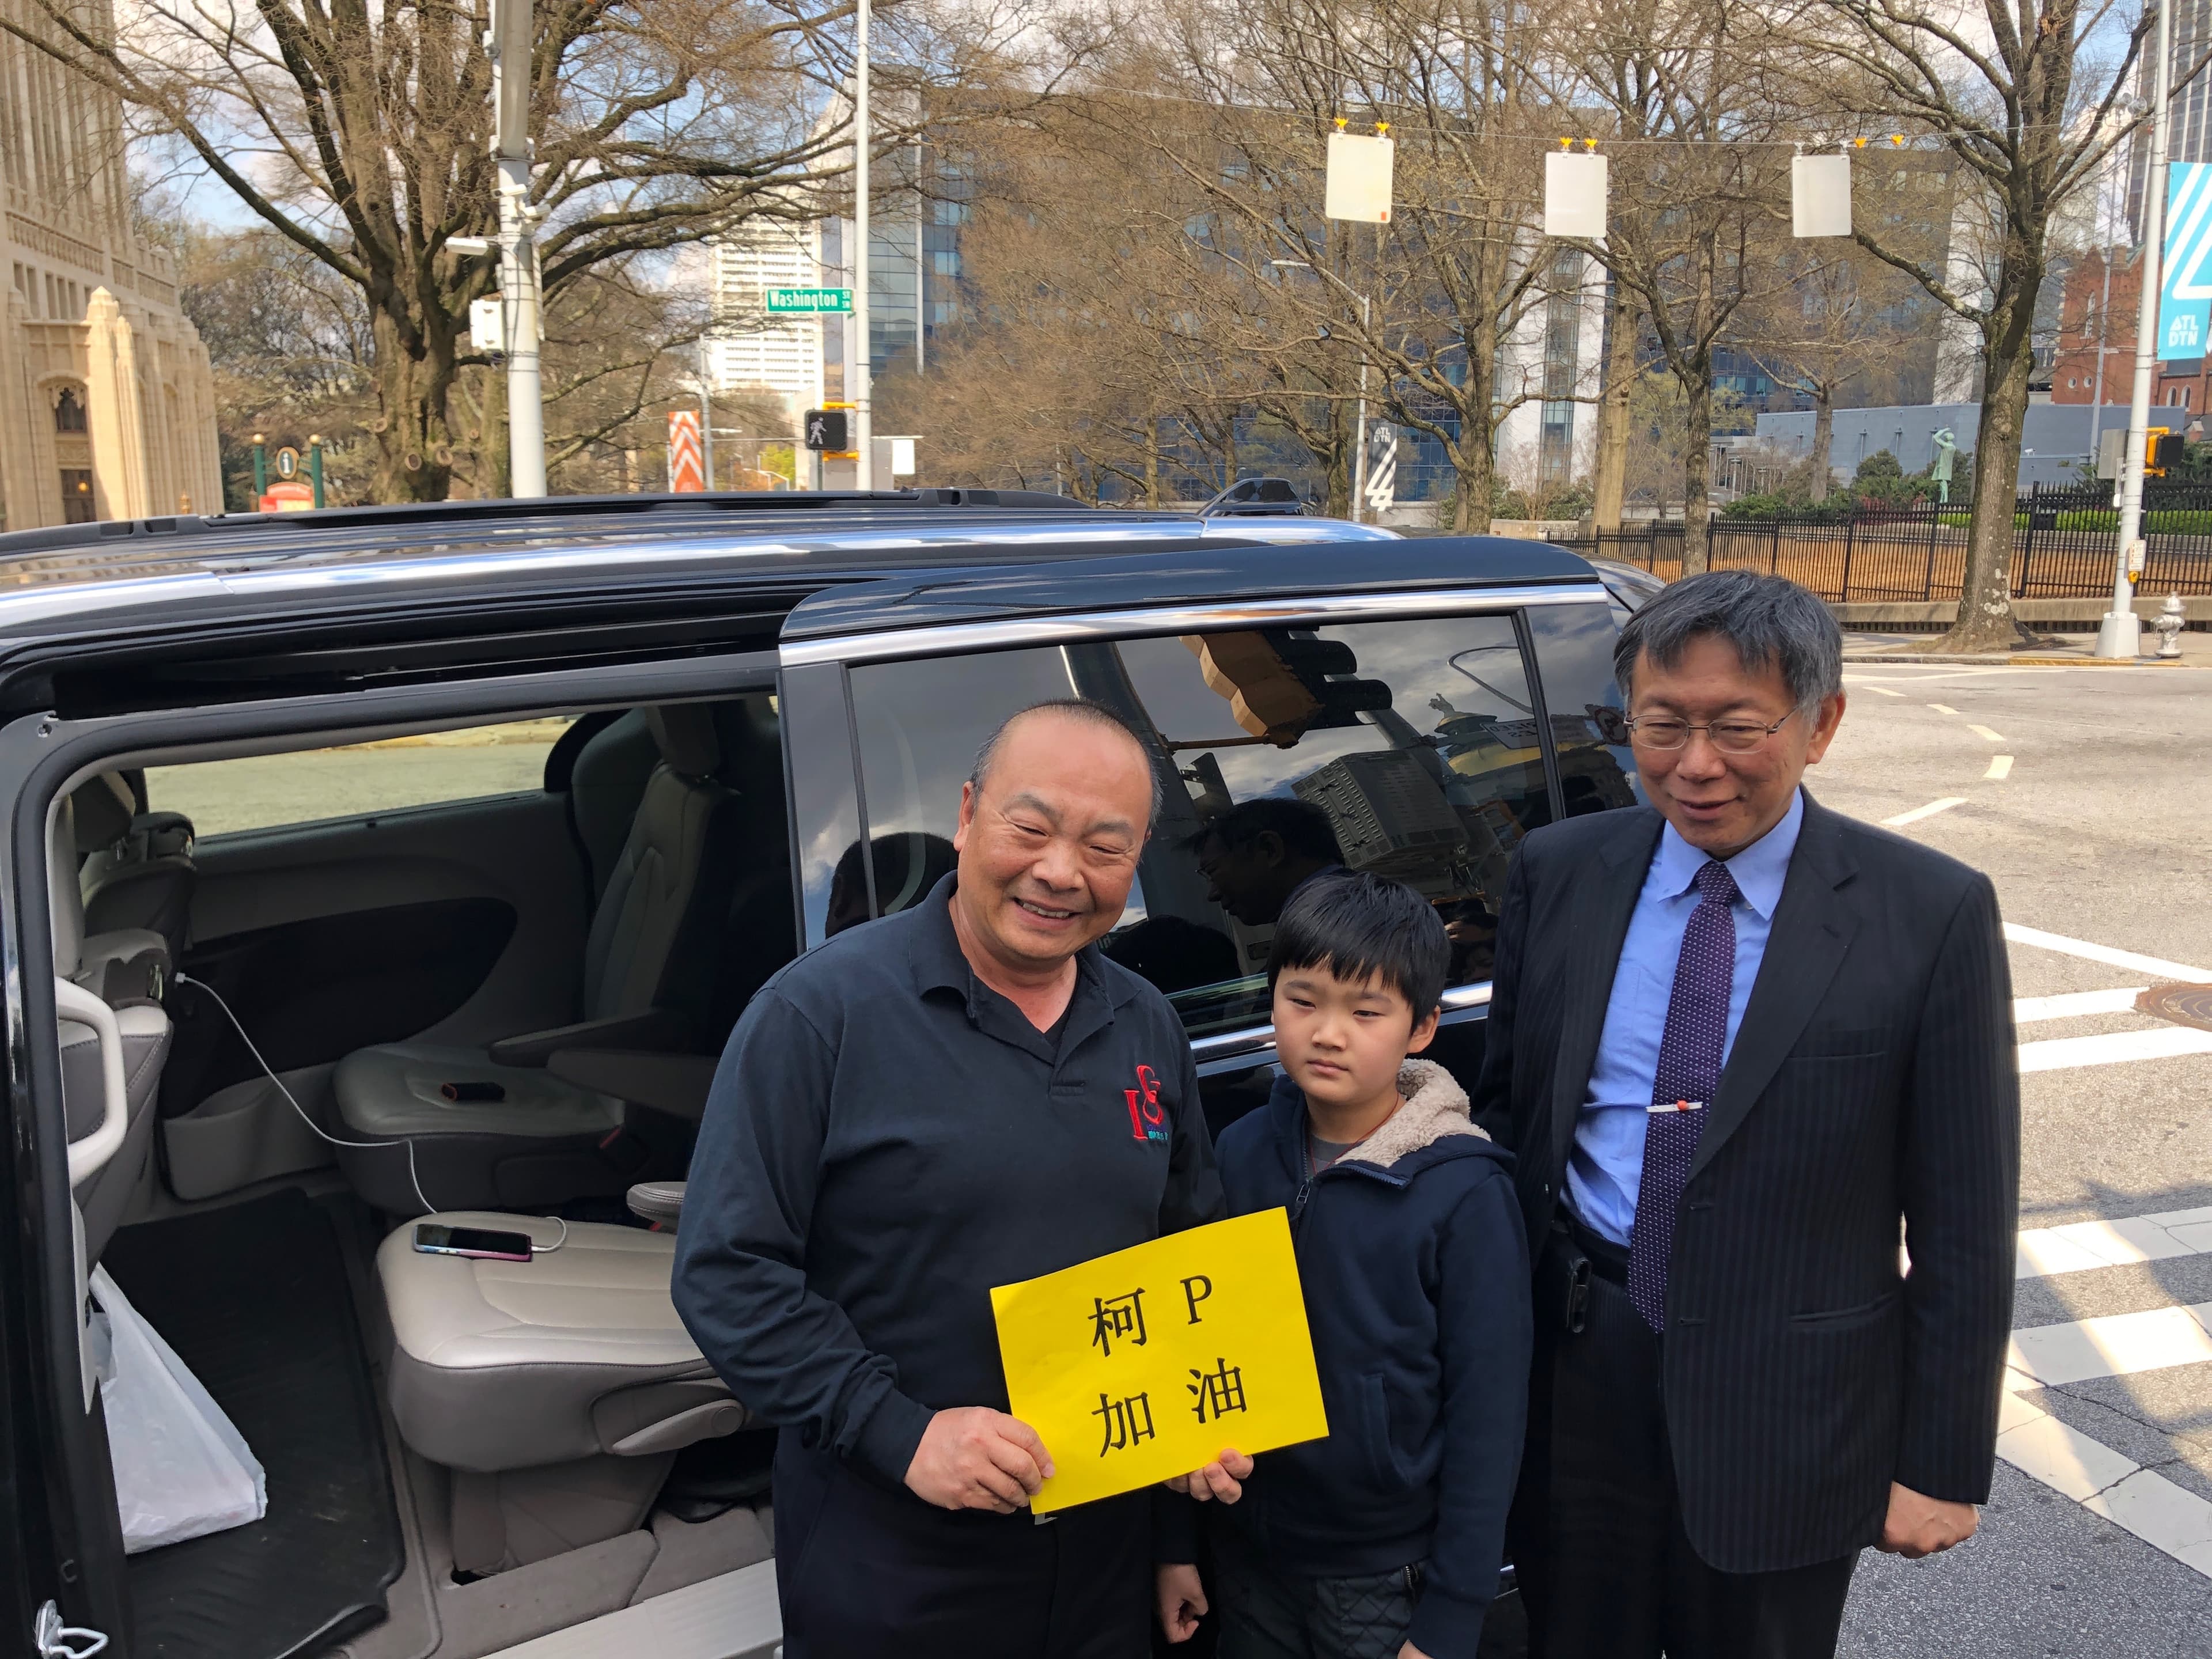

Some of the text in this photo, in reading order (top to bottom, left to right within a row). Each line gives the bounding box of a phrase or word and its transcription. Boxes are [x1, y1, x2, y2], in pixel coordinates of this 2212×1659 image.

[770, 290, 838, 311] Washington
[2169, 314, 2199, 331] ATL
[2168, 331, 2198, 347] DTN
[1375, 427, 1391, 435] ATL
[1091, 1357, 1248, 1458] 加油
